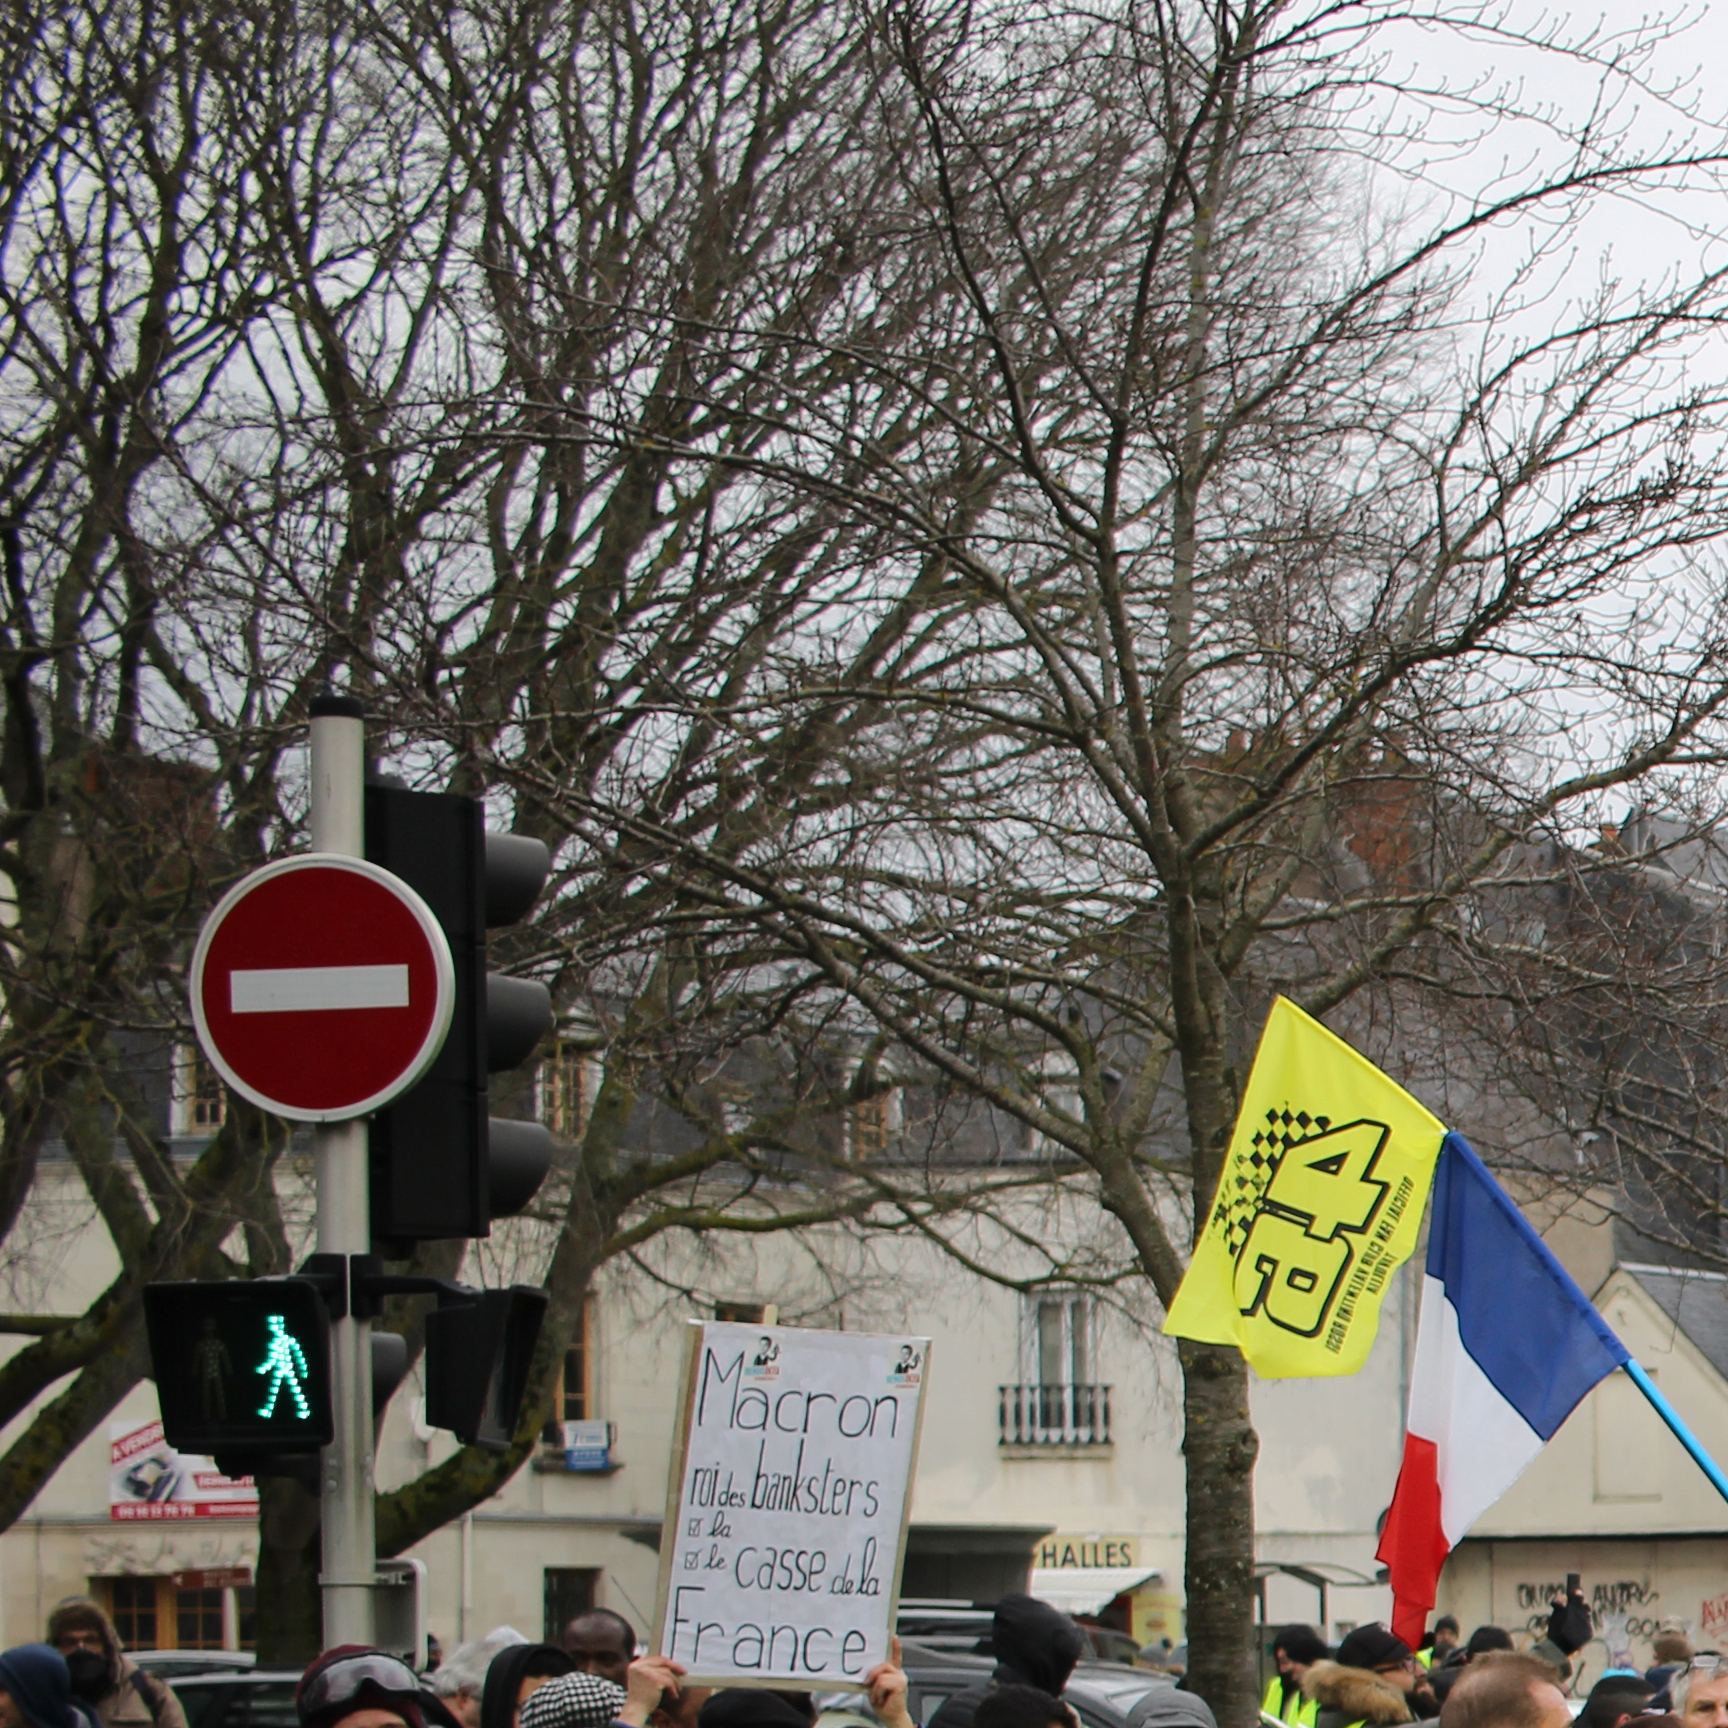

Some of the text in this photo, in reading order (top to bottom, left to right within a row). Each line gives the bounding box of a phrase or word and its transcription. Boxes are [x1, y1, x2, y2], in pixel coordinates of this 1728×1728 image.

[698, 1347, 898, 1438] Macron
[690, 1438, 880, 1518] roi des banksters
[707, 1511, 733, 1538] la
[1042, 1542, 1132, 1568] HALLES
[704, 1544, 728, 1571] le
[829, 1553, 854, 1595] de
[855, 1536, 881, 1597] la
[670, 1586, 867, 1676] France
